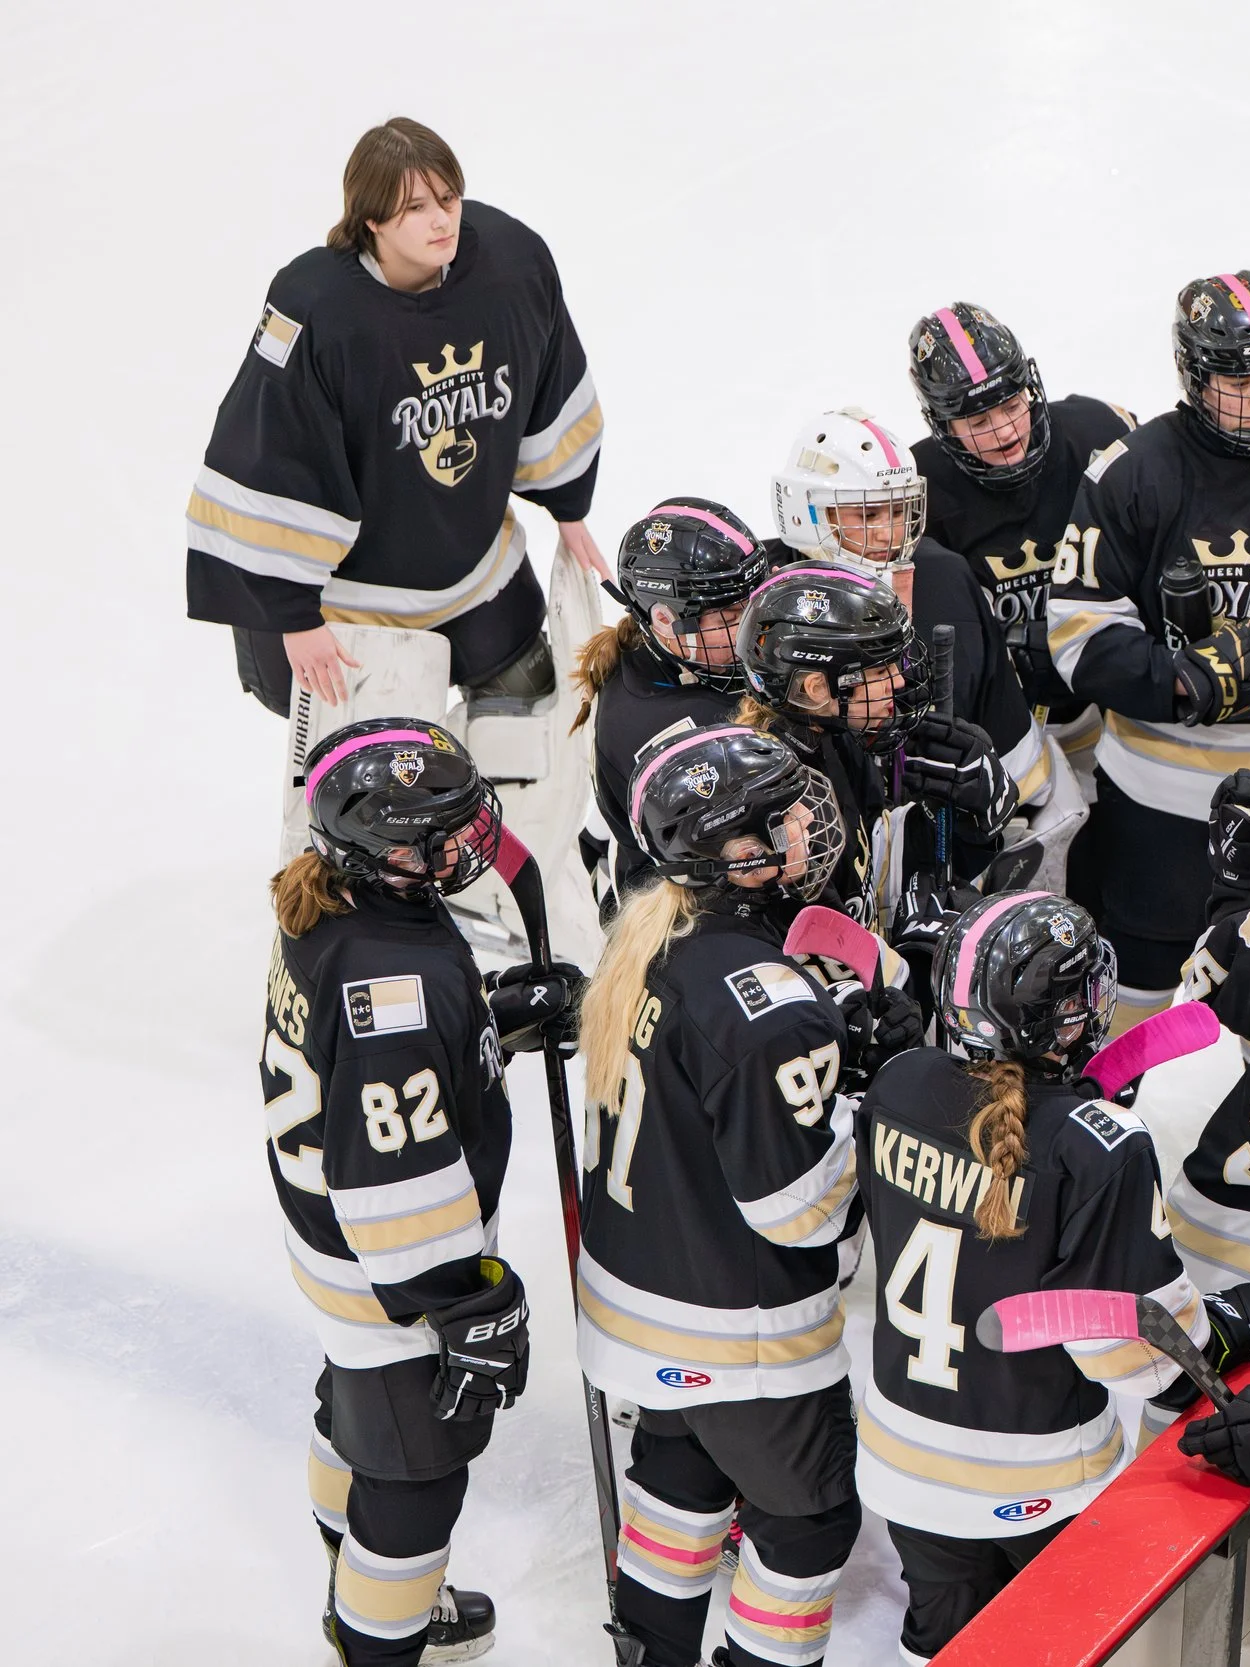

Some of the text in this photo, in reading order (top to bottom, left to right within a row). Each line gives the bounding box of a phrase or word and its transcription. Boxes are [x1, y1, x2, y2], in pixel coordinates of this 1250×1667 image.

[422, 371, 484, 400] QUEEN CITY
[391, 364, 512, 451] ROYALS
[876, 466, 913, 478] BAUER
[775, 481, 787, 535] BAUER
[744, 556, 766, 581] CCM
[1051, 523, 1101, 589] 61
[636, 580, 672, 591] CCM
[995, 574, 1037, 594] QUEEN
[792, 650, 834, 663] CCM
[390, 756, 425, 775] ROYALS
[684, 766, 720, 790] ROYALS
[728, 858, 767, 870] BAUER
[1059, 949, 1088, 973] BAUER
[775, 1039, 840, 1128] 97
[261, 1028, 328, 1197] 2
[361, 1067, 449, 1154] 82
[885, 1217, 965, 1392] 4
[588, 1382, 599, 1422] VAPO
